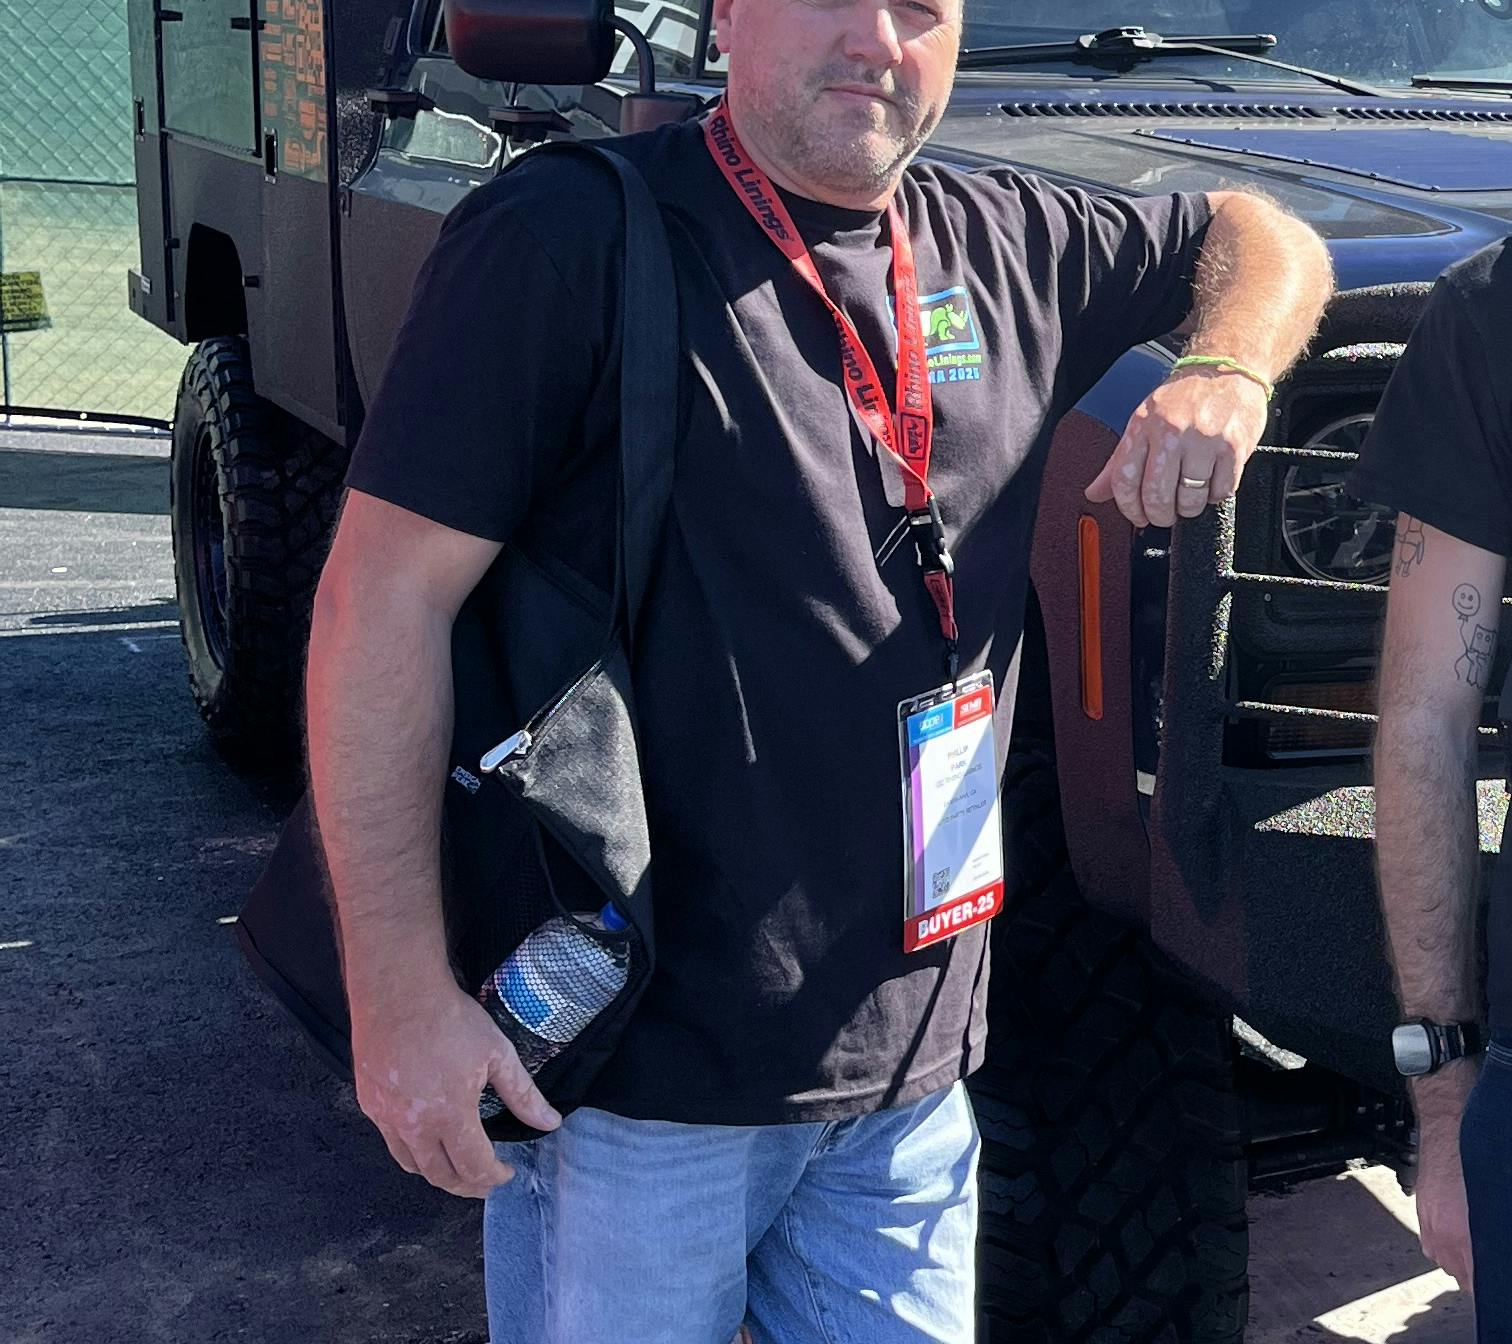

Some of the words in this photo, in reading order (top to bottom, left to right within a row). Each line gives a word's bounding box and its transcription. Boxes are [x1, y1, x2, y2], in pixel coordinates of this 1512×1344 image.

[711, 116, 741, 166] Rhino
[734, 168, 791, 240] Linings
[917, 892, 995, 939] BUYER-25
